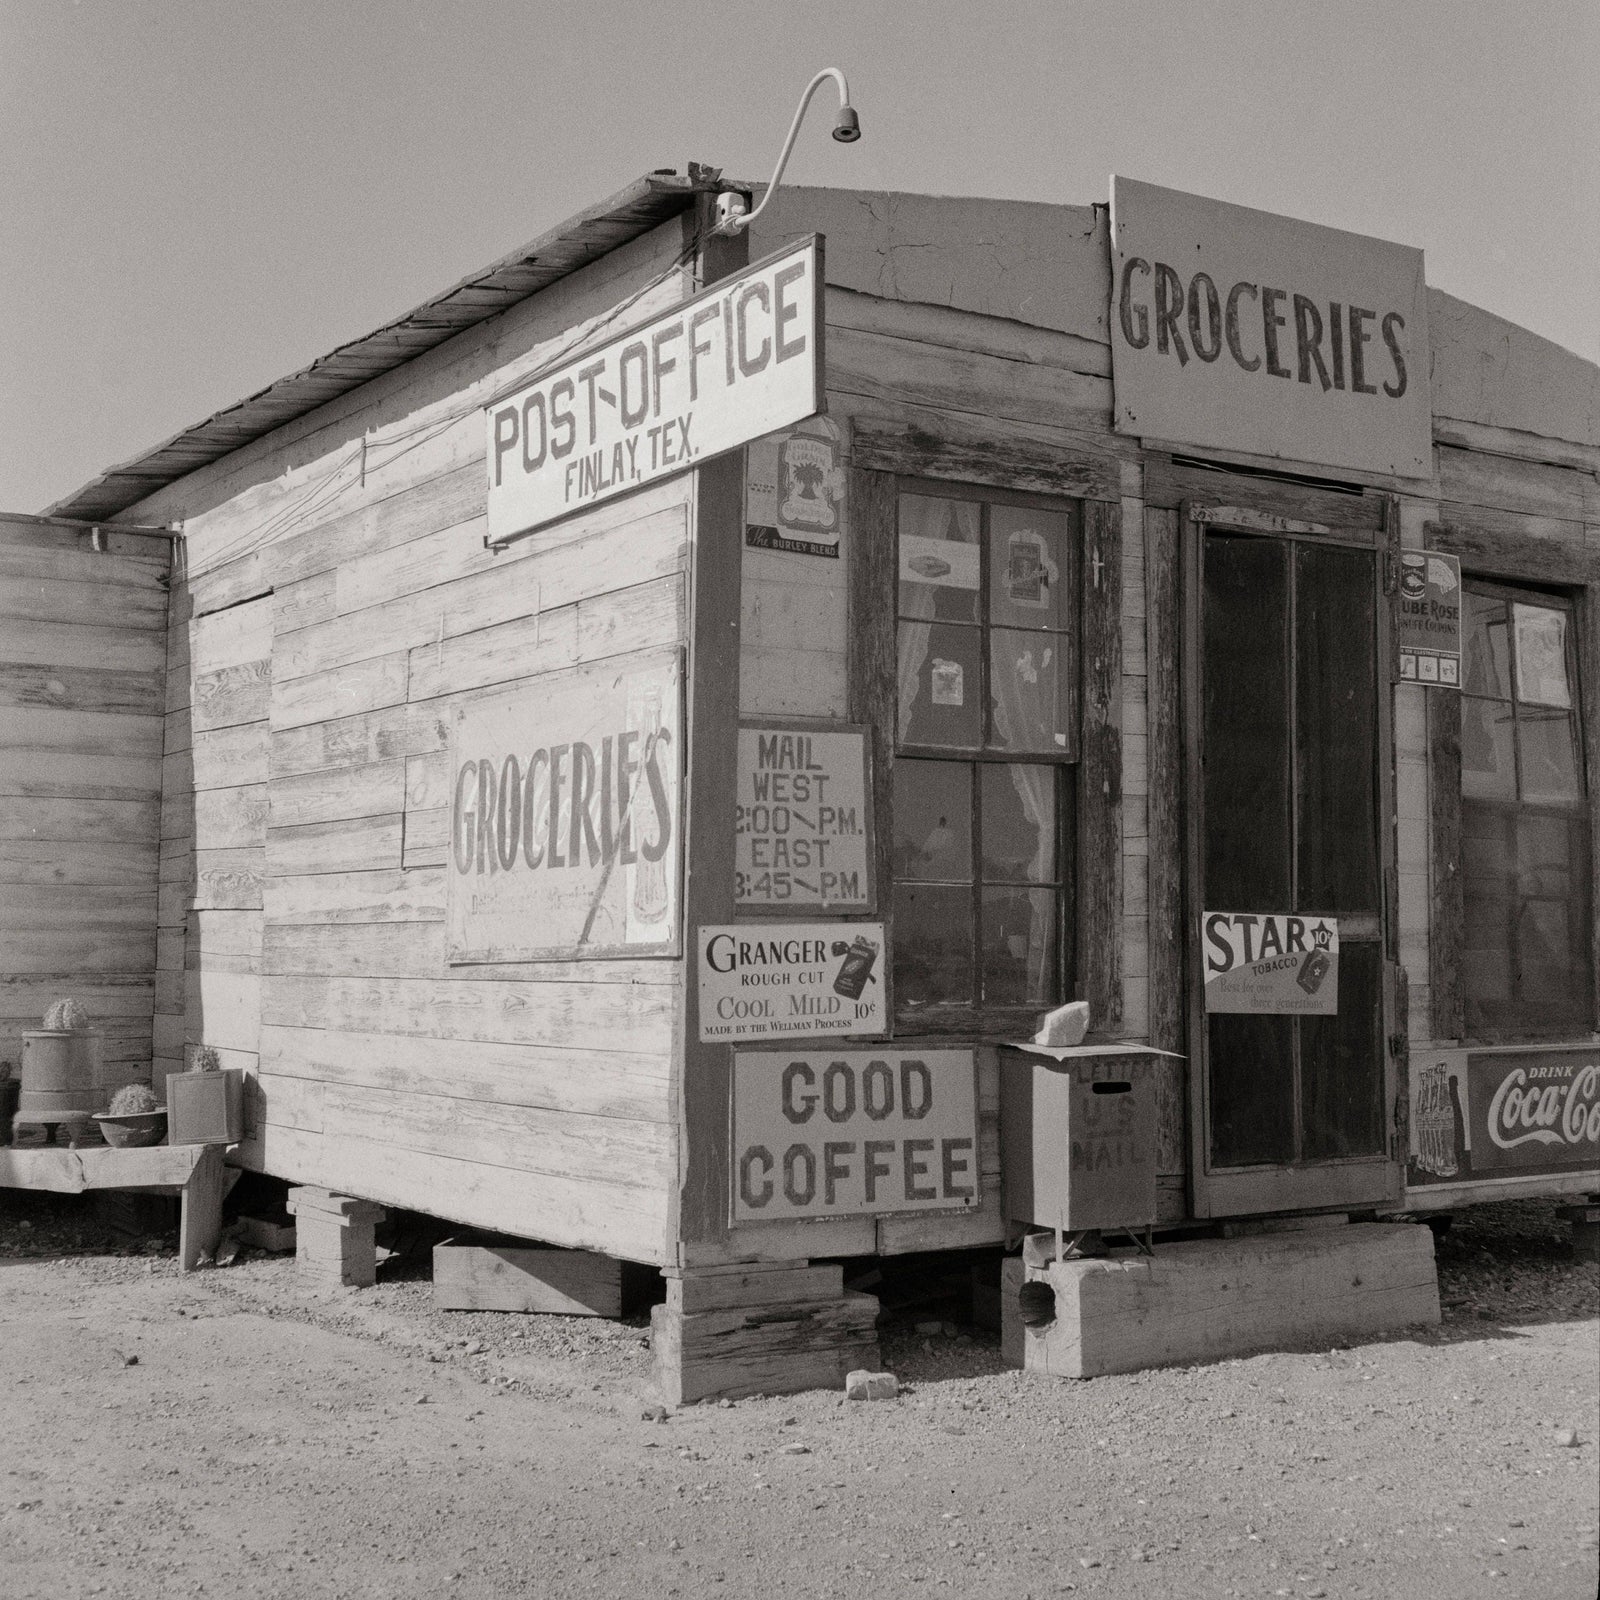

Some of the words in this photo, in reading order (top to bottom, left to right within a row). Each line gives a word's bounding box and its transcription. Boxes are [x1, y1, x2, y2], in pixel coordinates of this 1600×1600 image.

[1119, 256, 1408, 399] GROCERIES
[565, 434, 641, 503] FINLAY,
[647, 412, 699, 470] TEX.
[747, 524, 768, 546] The
[772, 539, 807, 552] BURLEY
[810, 543, 836, 556] BLEND
[1400, 601, 1429, 616] UBE
[1431, 599, 1459, 621] ROSE
[758, 734, 822, 770] MAIL
[453, 727, 672, 877] GROCERIES
[752, 772, 830, 803] WEST
[751, 838, 830, 868] EAST
[705, 933, 827, 973] GRANGER
[1205, 913, 1308, 973] STAR
[741, 973, 790, 986] ROUGH
[799, 971, 824, 985] CUT
[1251, 957, 1298, 976] TOBACCO
[716, 996, 775, 1019] COOL
[788, 994, 841, 1016] MILD
[854, 1002, 876, 1019] 10¢
[704, 1026, 732, 1035] MADE
[735, 1025, 747, 1034] BY
[750, 1024, 767, 1033] THE
[770, 1021, 812, 1032] WELLMAN
[815, 1019, 852, 1029] PROCESS
[1529, 1066, 1573, 1079] DRINK
[781, 1060, 933, 1124] GOOD
[1072, 1140, 1147, 1172] MAIL
[740, 1137, 975, 1209] COFFEE
